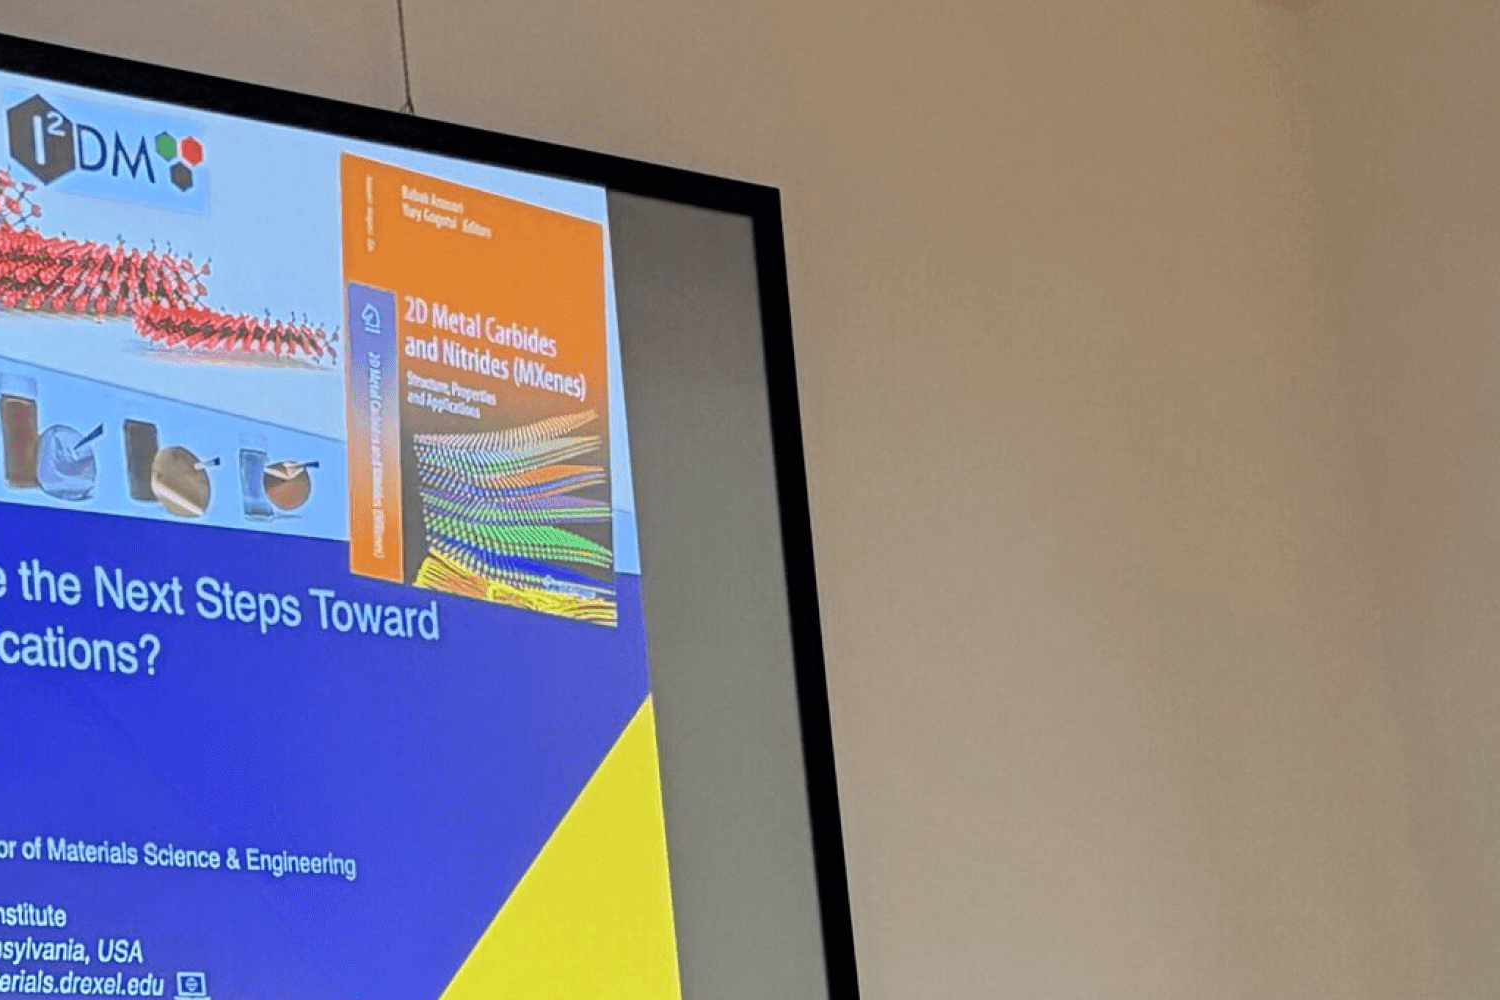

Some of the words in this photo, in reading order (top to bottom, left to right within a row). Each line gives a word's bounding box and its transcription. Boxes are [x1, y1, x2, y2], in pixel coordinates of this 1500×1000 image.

[404, 295, 428, 324] 2D
[432, 302, 481, 338] Metal
[485, 316, 558, 358] Carbides
[405, 336, 438, 362] and
[442, 338, 509, 380] Nitrides
[514, 356, 586, 402] (MXenes)
[18, 558, 81, 605] the
[94, 565, 184, 615] Next
[196, 576, 301, 634] Steps
[309, 588, 439, 640] Toward
[22, 836, 41, 860] of
[47, 837, 138, 865] Materials
[144, 843, 221, 869] Science
[226, 848, 240, 870] &
[246, 848, 357, 881] Engineering
[98, 939, 143, 964] USA
